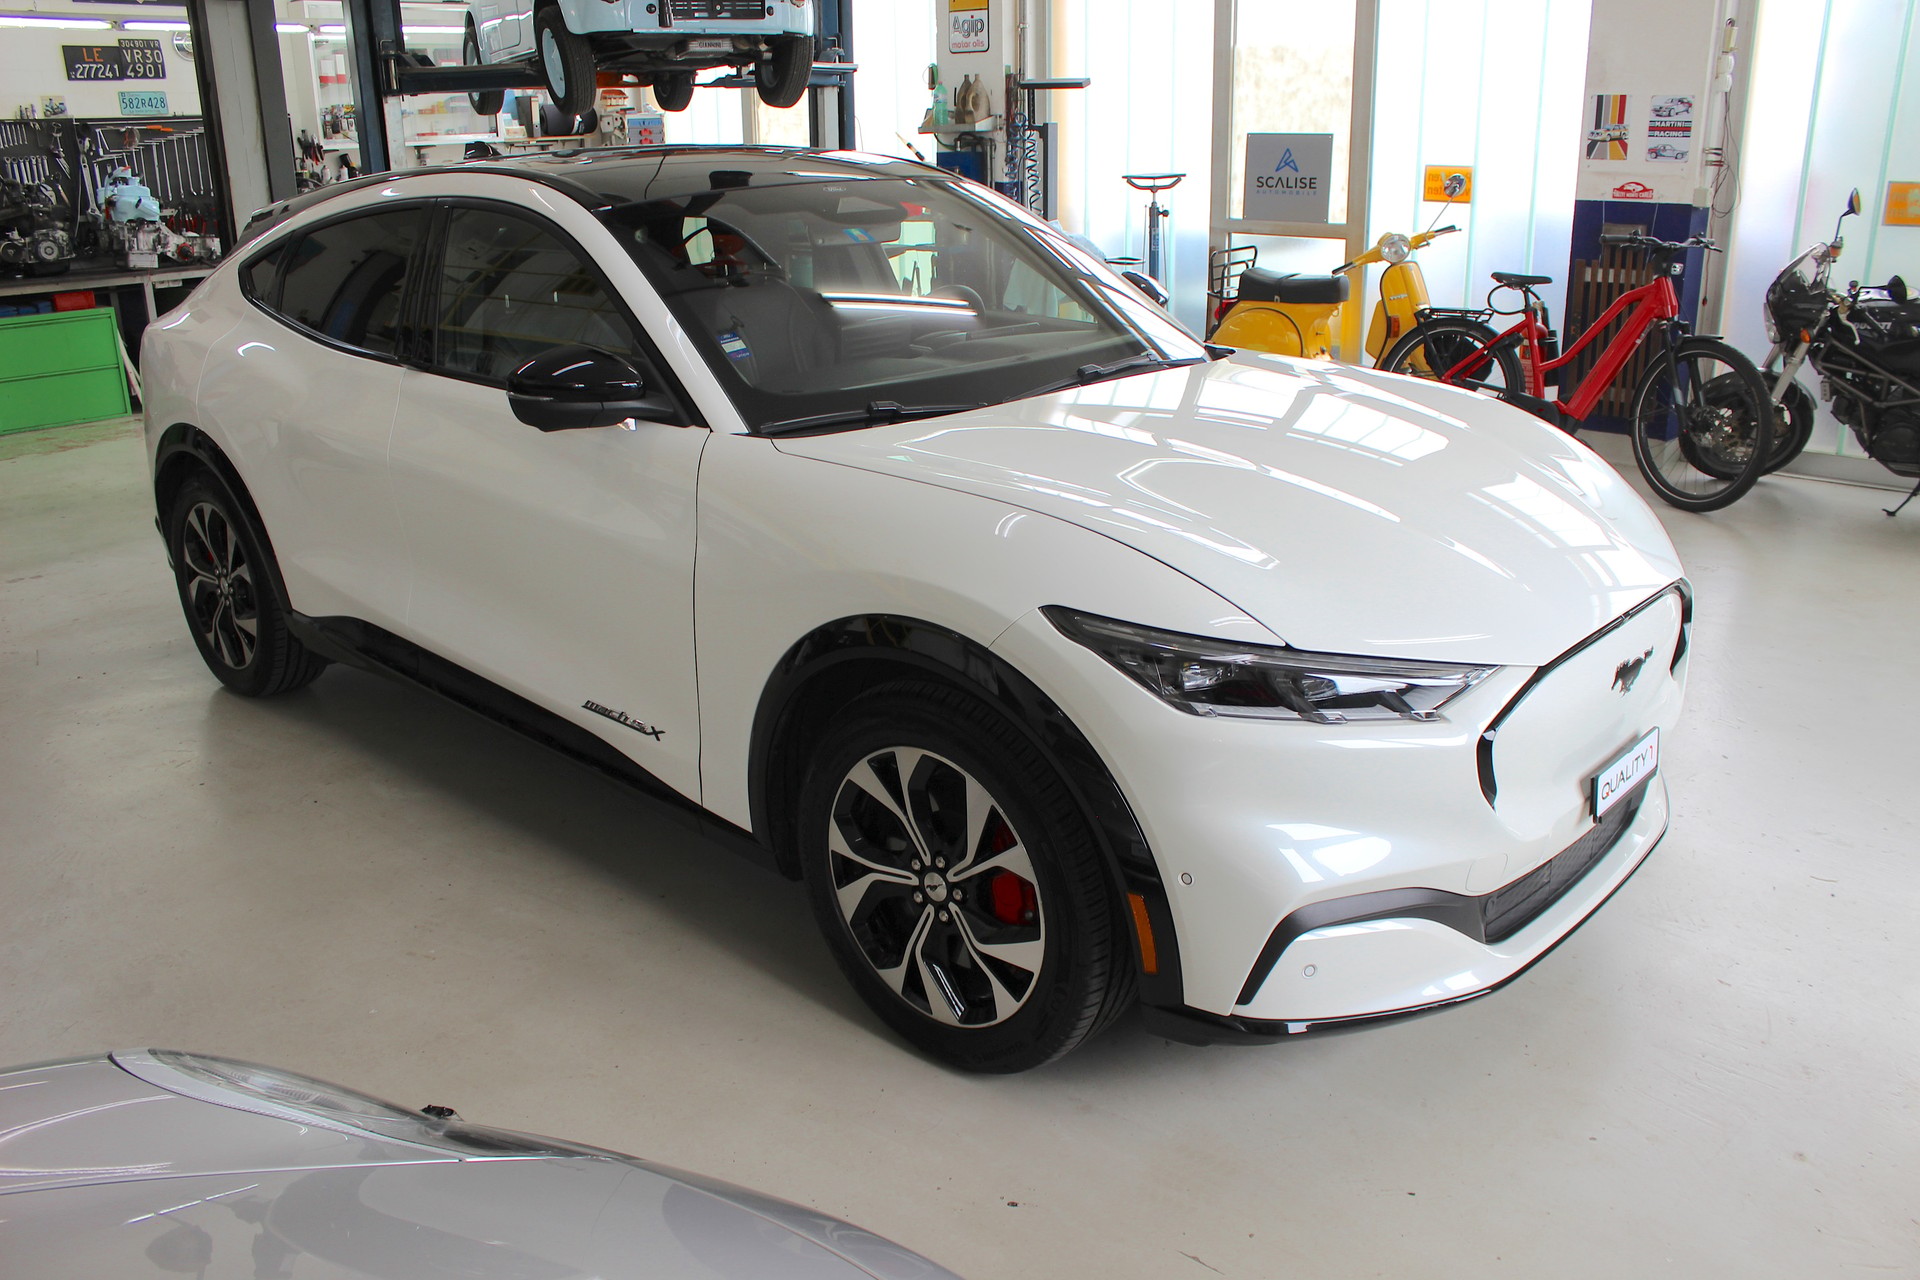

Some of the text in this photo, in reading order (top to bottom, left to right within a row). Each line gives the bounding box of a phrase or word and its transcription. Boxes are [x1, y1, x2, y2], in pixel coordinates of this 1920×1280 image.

[953, 15, 985, 39] Agip
[120, 40, 159, 48] 304901 VR
[952, 39, 985, 49] motor oils
[82, 47, 104, 62] LE
[123, 49, 163, 63] VR30
[75, 63, 120, 79] 277241
[126, 64, 163, 78] 4901
[121, 97, 166, 110] 582R428
[1654, 130, 1684, 138] RACING
[1256, 176, 1318, 190] SCALISE
[1601, 748, 1648, 801] QUALITY
